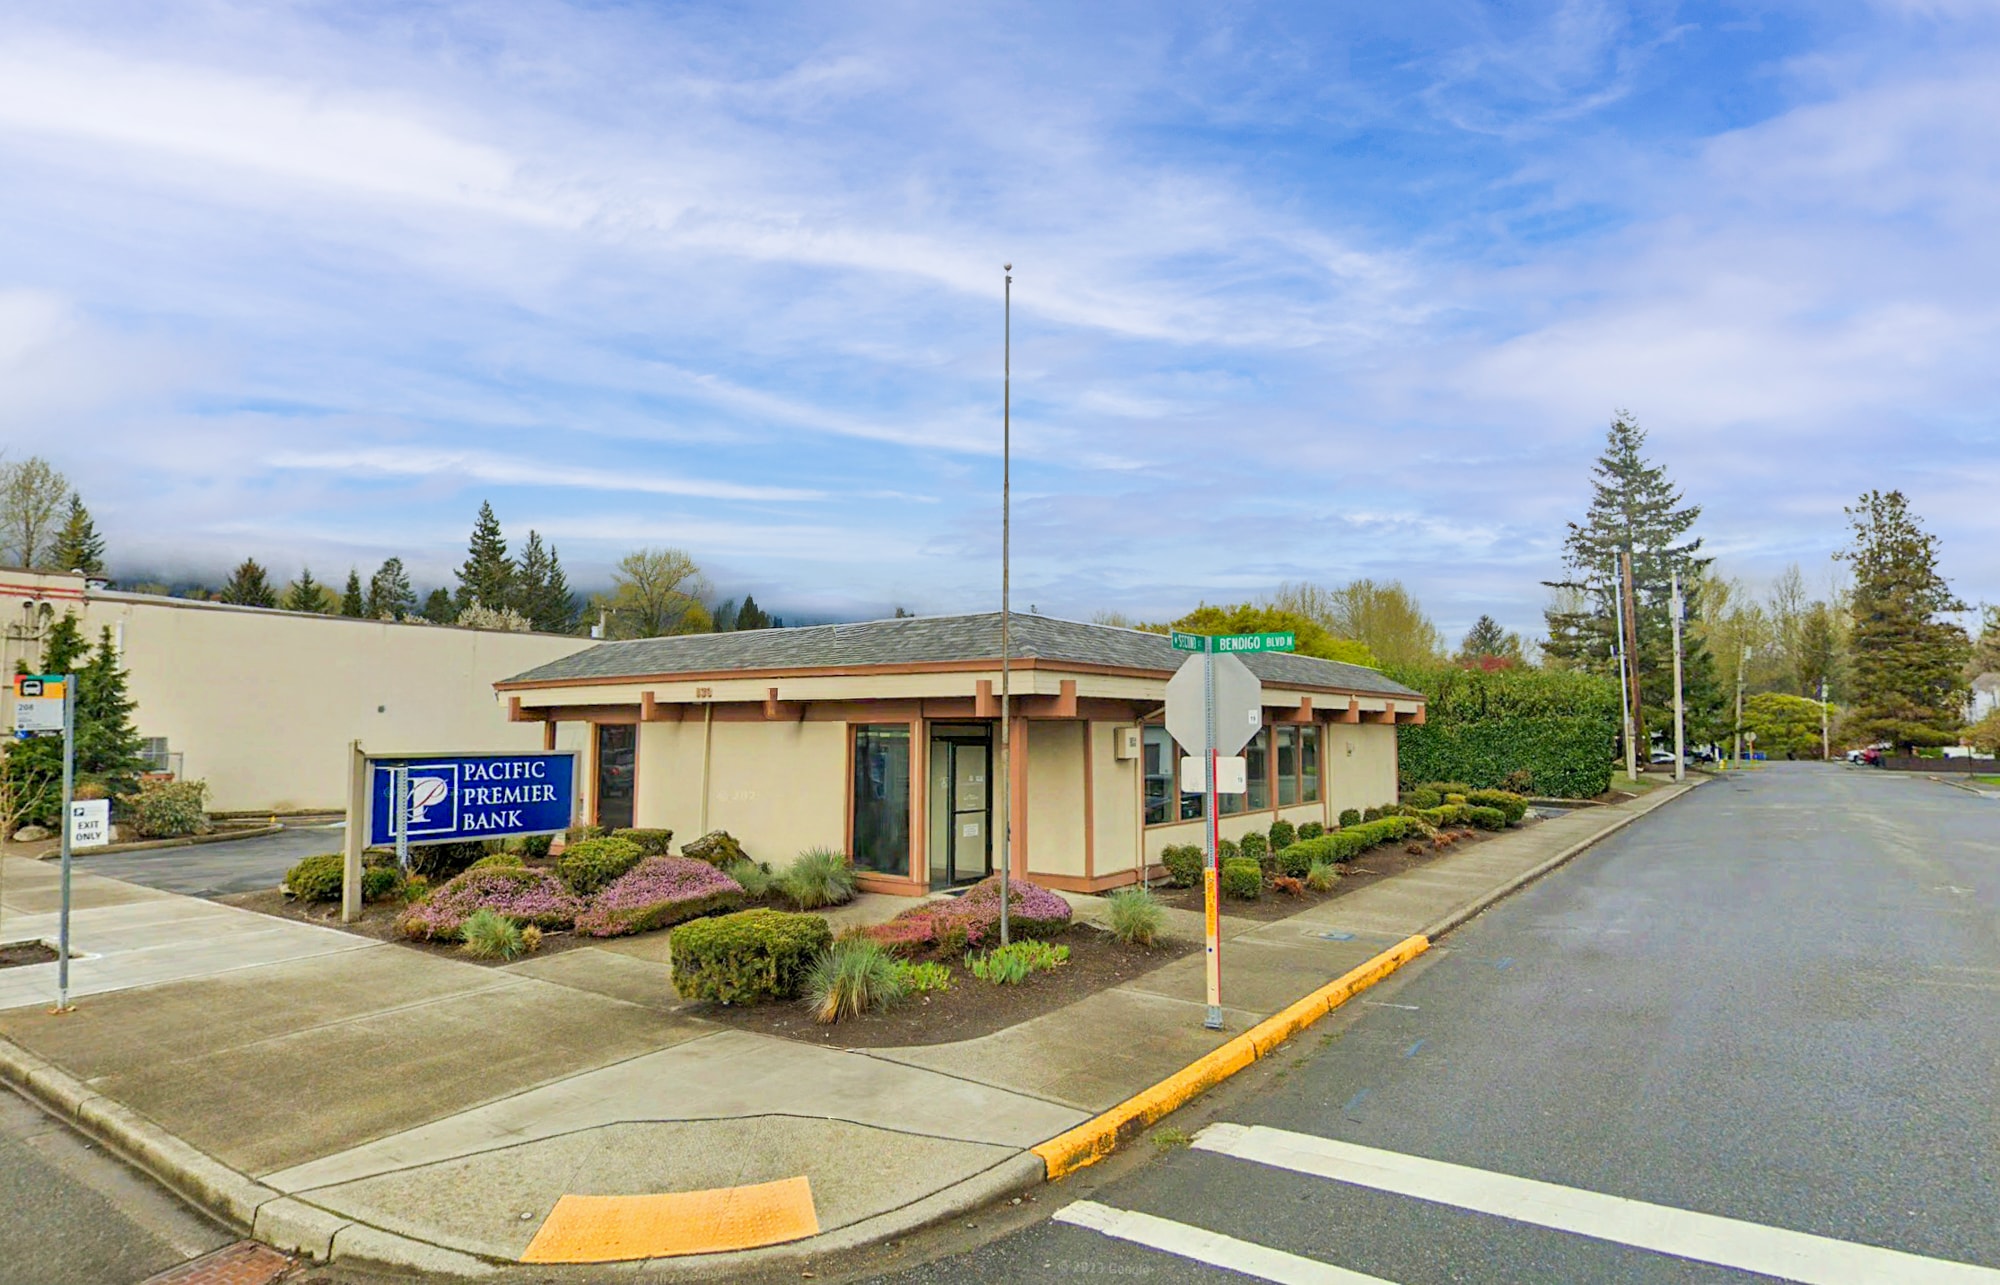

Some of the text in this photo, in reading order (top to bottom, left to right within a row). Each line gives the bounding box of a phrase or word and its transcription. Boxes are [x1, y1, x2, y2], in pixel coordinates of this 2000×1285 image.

[1219, 635, 1293, 651] BENDIGO BLVD N
[463, 761, 546, 782] PACIFIC
[463, 784, 558, 807] PREMIER
[78, 820, 99, 830] EXIT
[462, 809, 523, 831] BANK
[76, 831, 102, 842] ONLY
